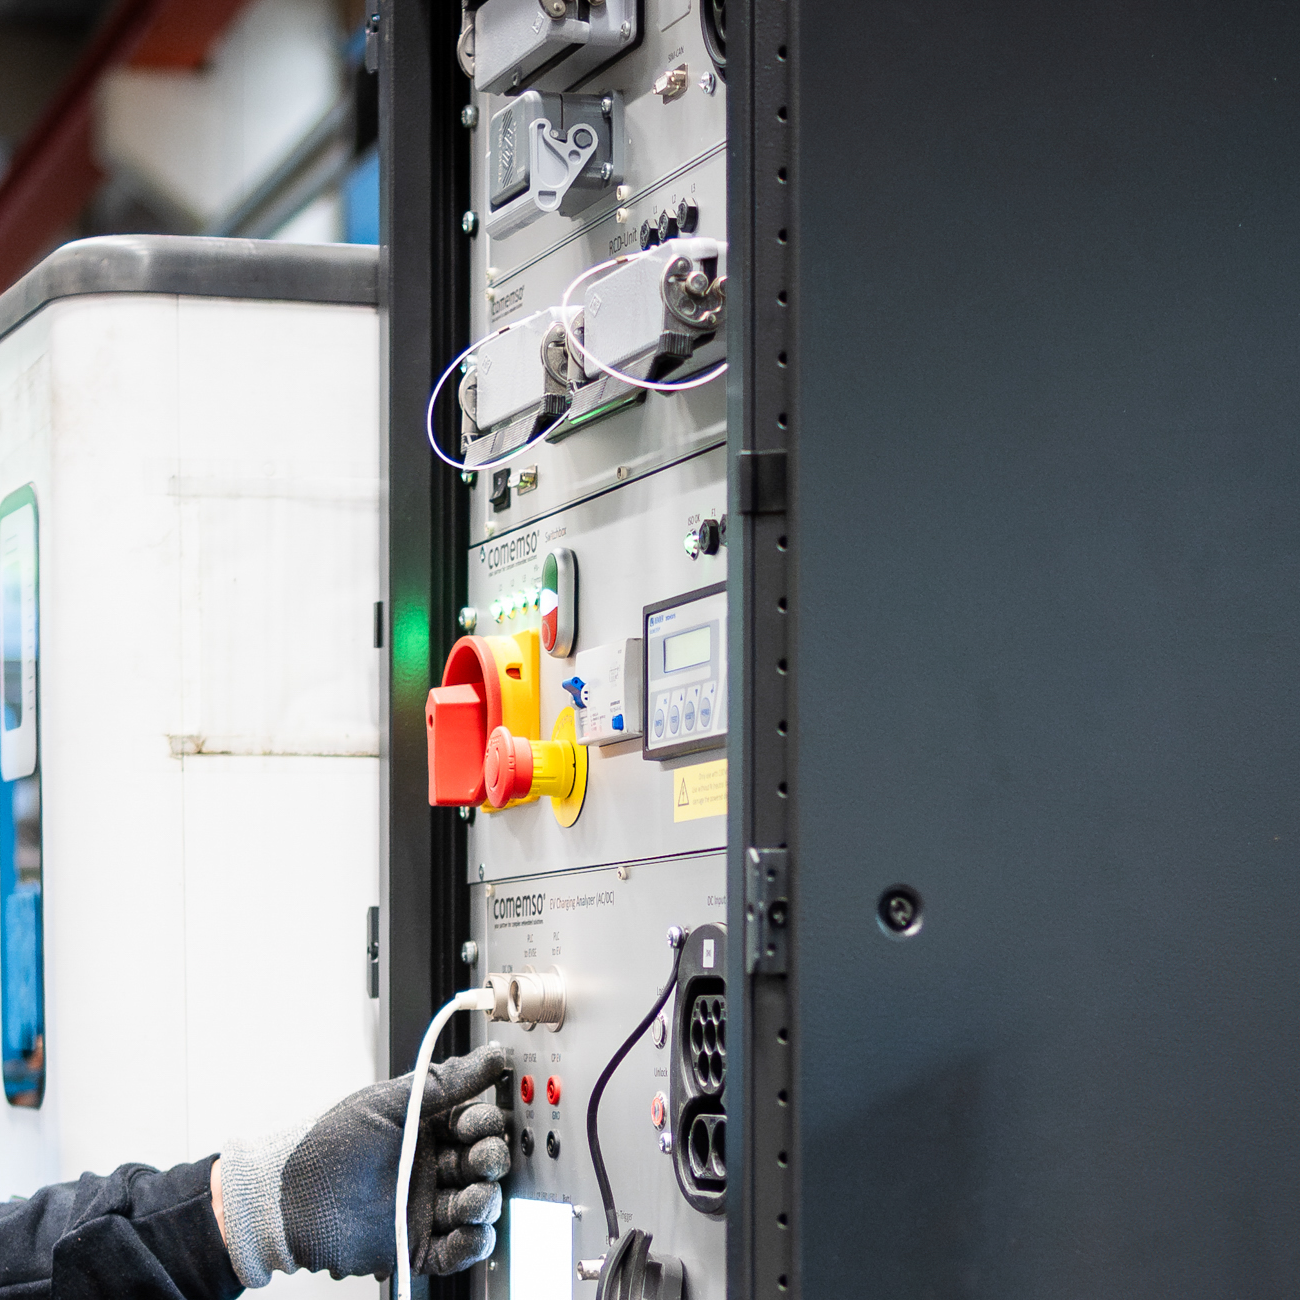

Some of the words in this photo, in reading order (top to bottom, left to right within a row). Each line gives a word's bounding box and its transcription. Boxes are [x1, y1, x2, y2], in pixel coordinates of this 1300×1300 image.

[609, 228, 637, 256] RCD-Unit
[488, 531, 537, 570] comemso
[494, 894, 543, 919] comemso
[557, 897, 576, 911] Charging
[576, 895, 595, 909] Analyzer
[596, 890, 615, 907] (AC/DC)
[654, 1067, 668, 1077] Unlock
